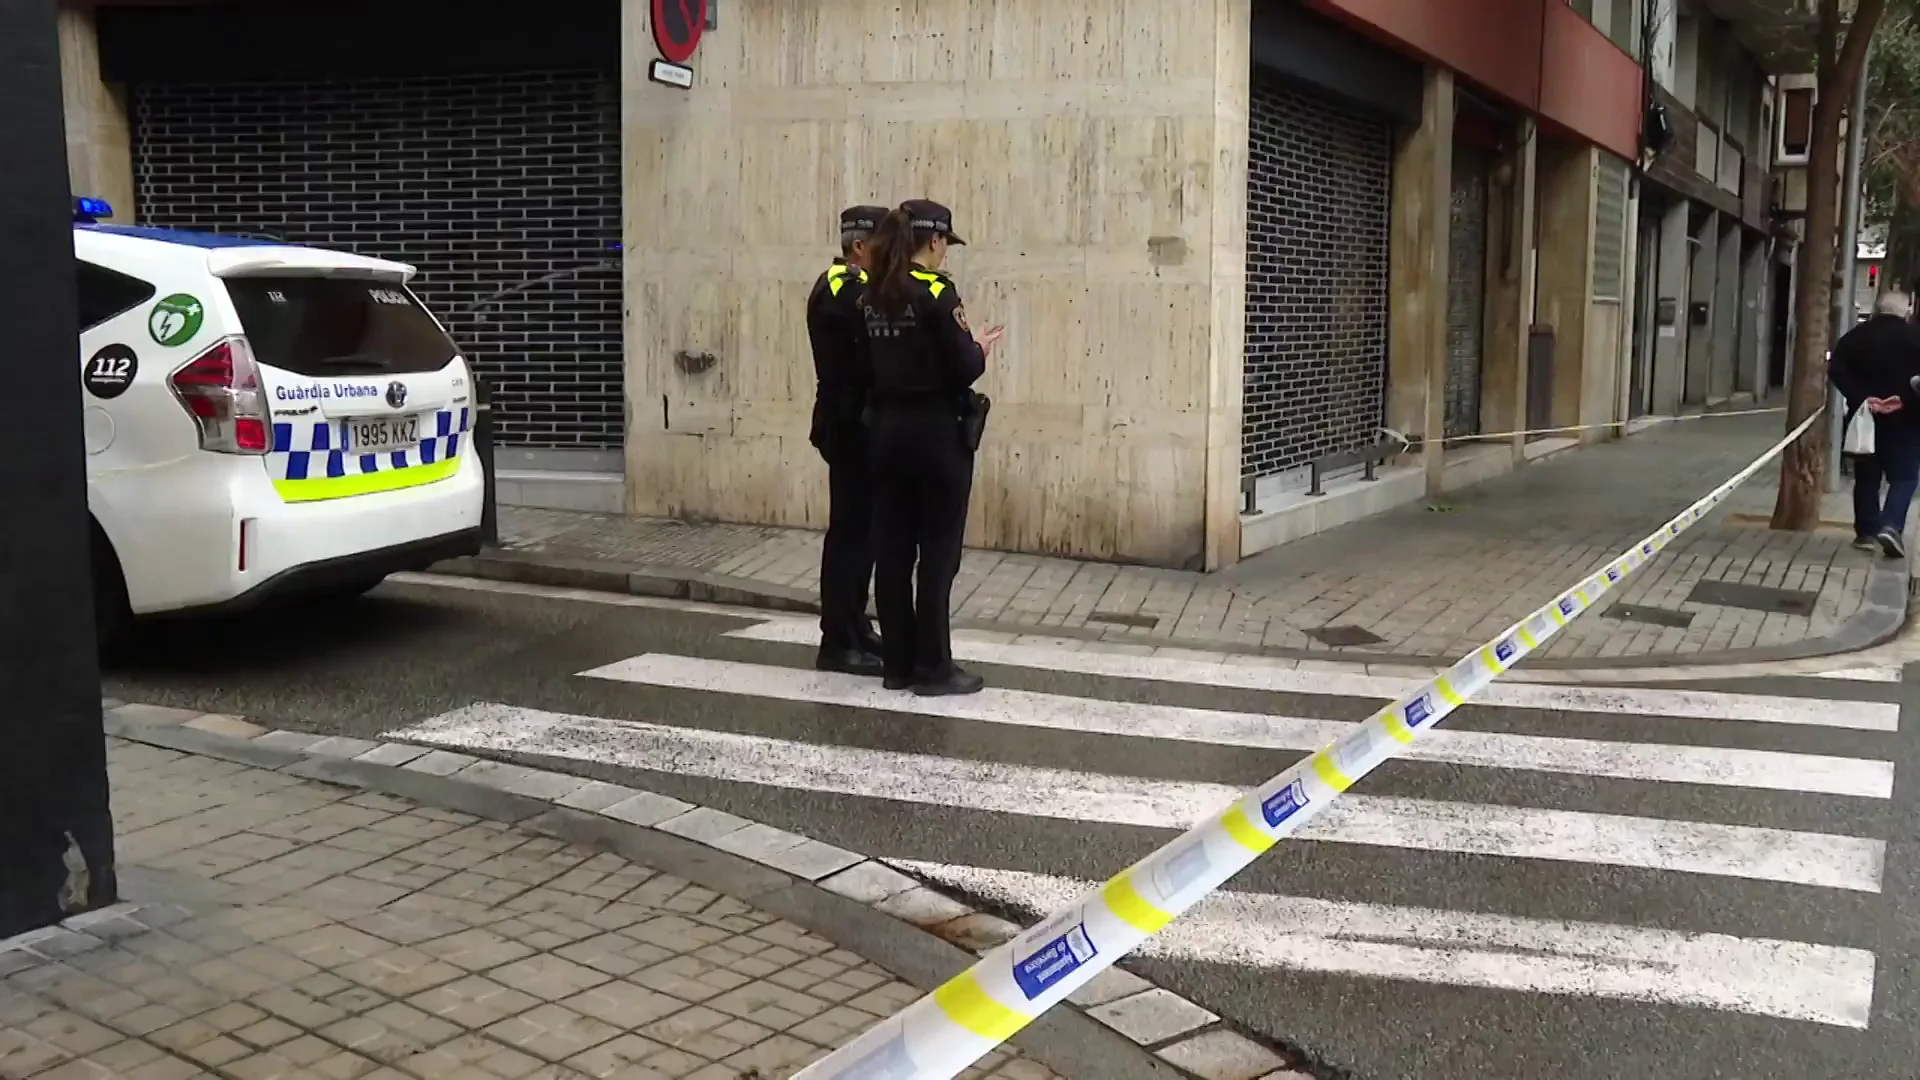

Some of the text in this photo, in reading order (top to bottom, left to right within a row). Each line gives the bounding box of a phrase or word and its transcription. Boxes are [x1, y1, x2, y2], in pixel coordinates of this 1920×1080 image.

[92, 357, 131, 376] 112
[333, 383, 378, 398] Urbana
[353, 419, 417, 448] 1995 KKZ
